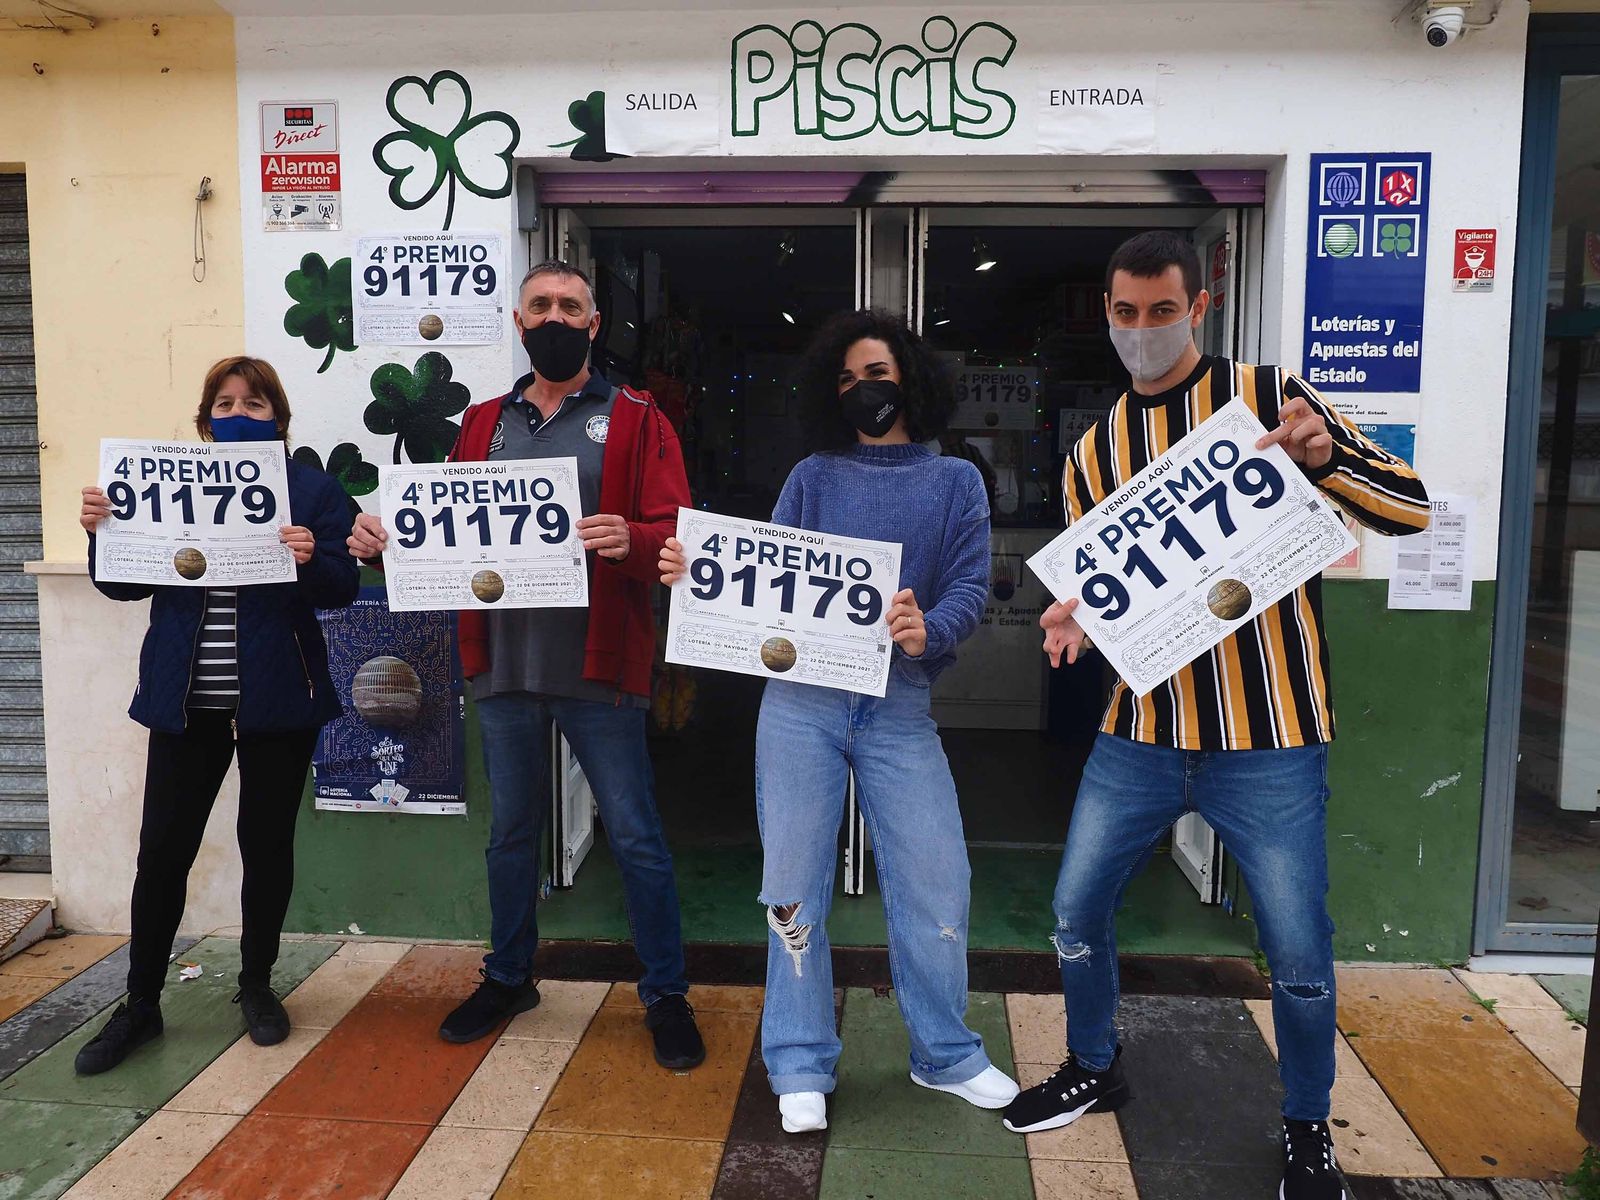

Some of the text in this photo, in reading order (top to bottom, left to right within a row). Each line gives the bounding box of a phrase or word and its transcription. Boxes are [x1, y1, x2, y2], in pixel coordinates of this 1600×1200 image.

[625, 93, 697, 111] SALIDA
[1049, 89, 1143, 107] ENTRADA
[274, 123, 328, 149] Direct
[265, 157, 337, 175] Alarma
[272, 176, 330, 185] zerovision
[1386, 175, 1394, 191] 1
[1389, 192, 1409, 205] 2
[1458, 232, 1494, 240] Vigilante
[394, 244, 488, 264] PREMIO
[363, 264, 497, 297] 91179
[1311, 315, 1396, 336] Loterías y
[1309, 341, 1418, 361] Apuestas del
[972, 373, 1026, 385] PREMIO
[1309, 367, 1367, 383] Estado
[152, 445, 211, 455] VENDIDO AQUÍ
[141, 457, 261, 483] PREMIO
[442, 465, 507, 476] VENDIDO AQUÍ
[430, 477, 555, 505] PREMIO
[1097, 439, 1241, 555] PREMIO
[1101, 457, 1175, 517] VENDIDO AQUÍ
[106, 480, 277, 525] 91179
[394, 502, 570, 549] 91179
[751, 525, 824, 546] VENDIDO AQUÍ
[1080, 457, 1285, 621] 91179
[735, 537, 873, 581] PREMIO
[1268, 566, 1277, 574] DE
[1277, 543, 1309, 567] DICIEMBRE
[1308, 533, 1323, 545] 2021
[689, 557, 883, 626] 91179
[998, 618, 1031, 626] Estado
[723, 644, 749, 652] NAVIDAD
[1140, 645, 1164, 664] LOTERÍA
[1175, 620, 1201, 640] NAVIDAD
[827, 660, 857, 670] DICIEMBRE
